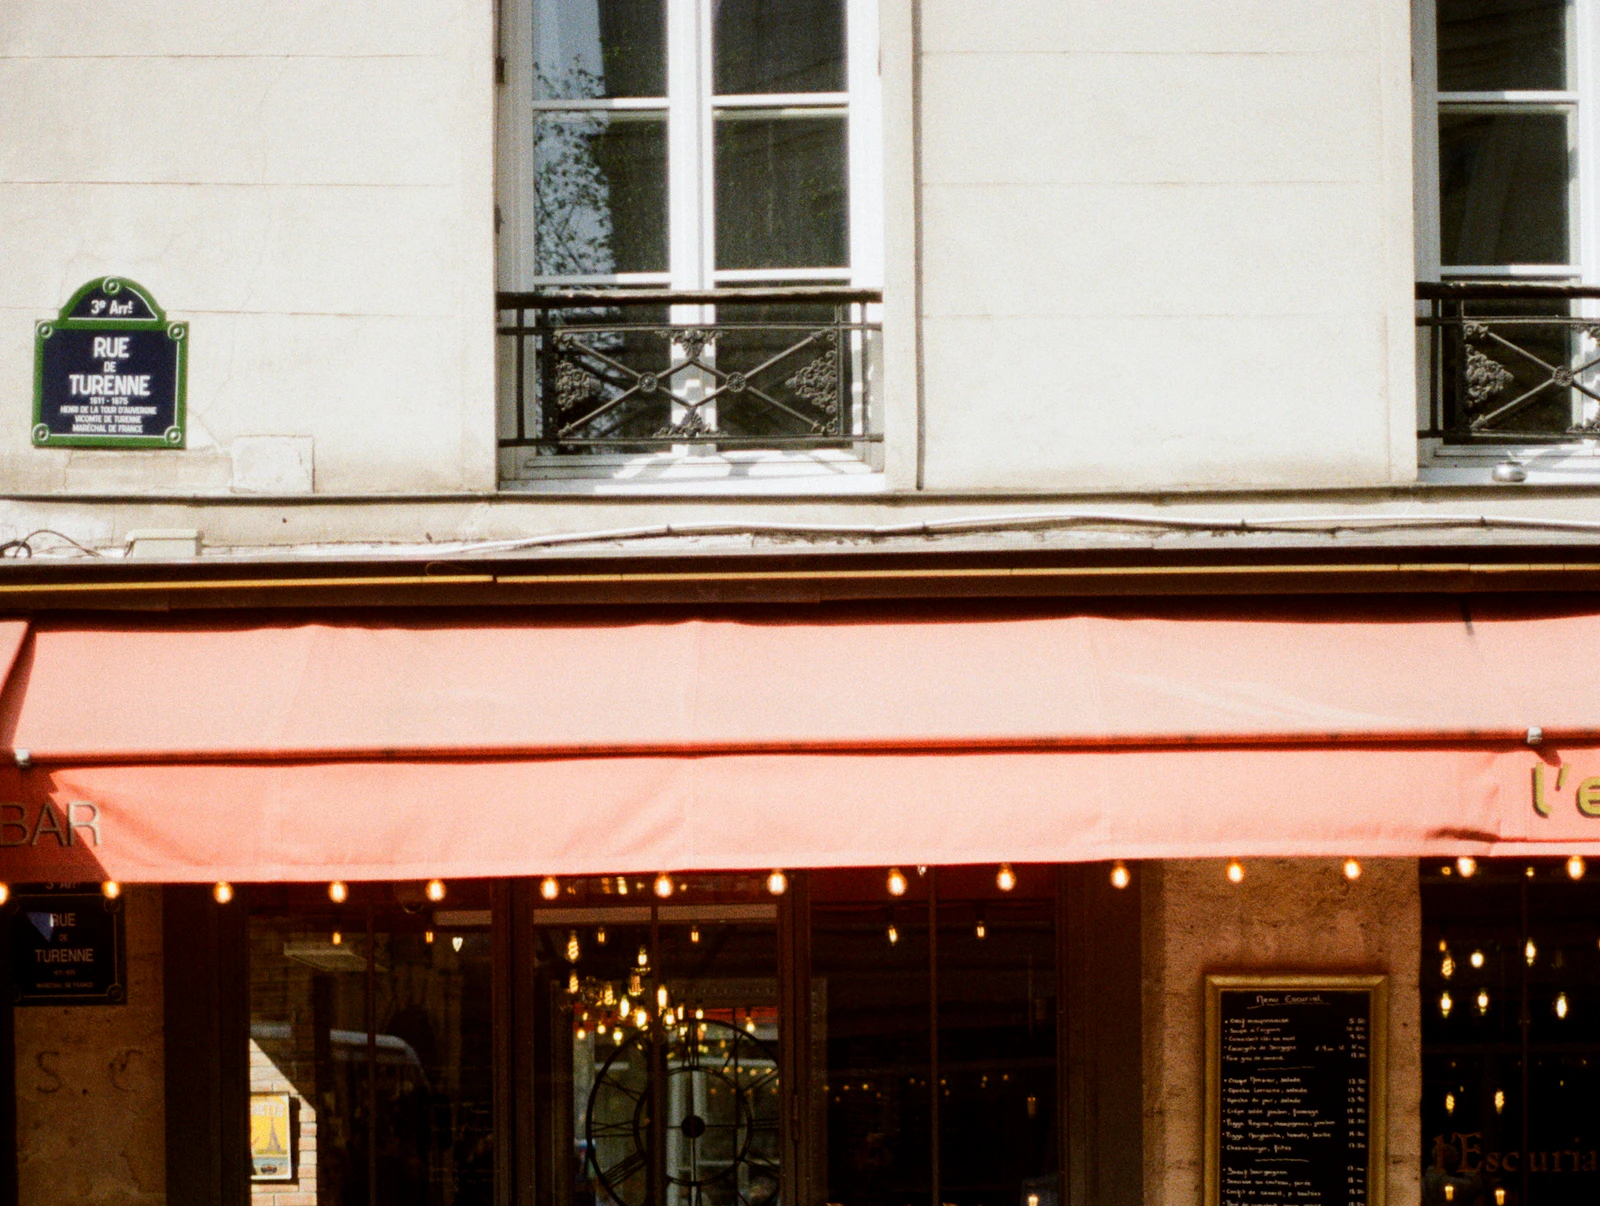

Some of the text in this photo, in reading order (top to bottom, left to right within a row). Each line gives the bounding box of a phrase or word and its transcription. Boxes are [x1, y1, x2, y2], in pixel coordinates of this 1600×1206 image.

[93, 336, 130, 359] RUE
[103, 361, 117, 373] DE
[69, 374, 151, 396] TURENNE
[60, 405, 157, 415] HENRI DE LA TOUR D'AUVERGNE
[75, 415, 142, 423] VICOMTE DE TURENNE
[108, 425, 118, 433] DE
[119, 425, 143, 434] FRANCE
[0, 800, 102, 848] BAR
[50, 912, 76, 927] RUE
[59, 933, 68, 942] DE
[34, 948, 94, 963] TURENNE
[1256, 994, 1279, 1006] Menu
